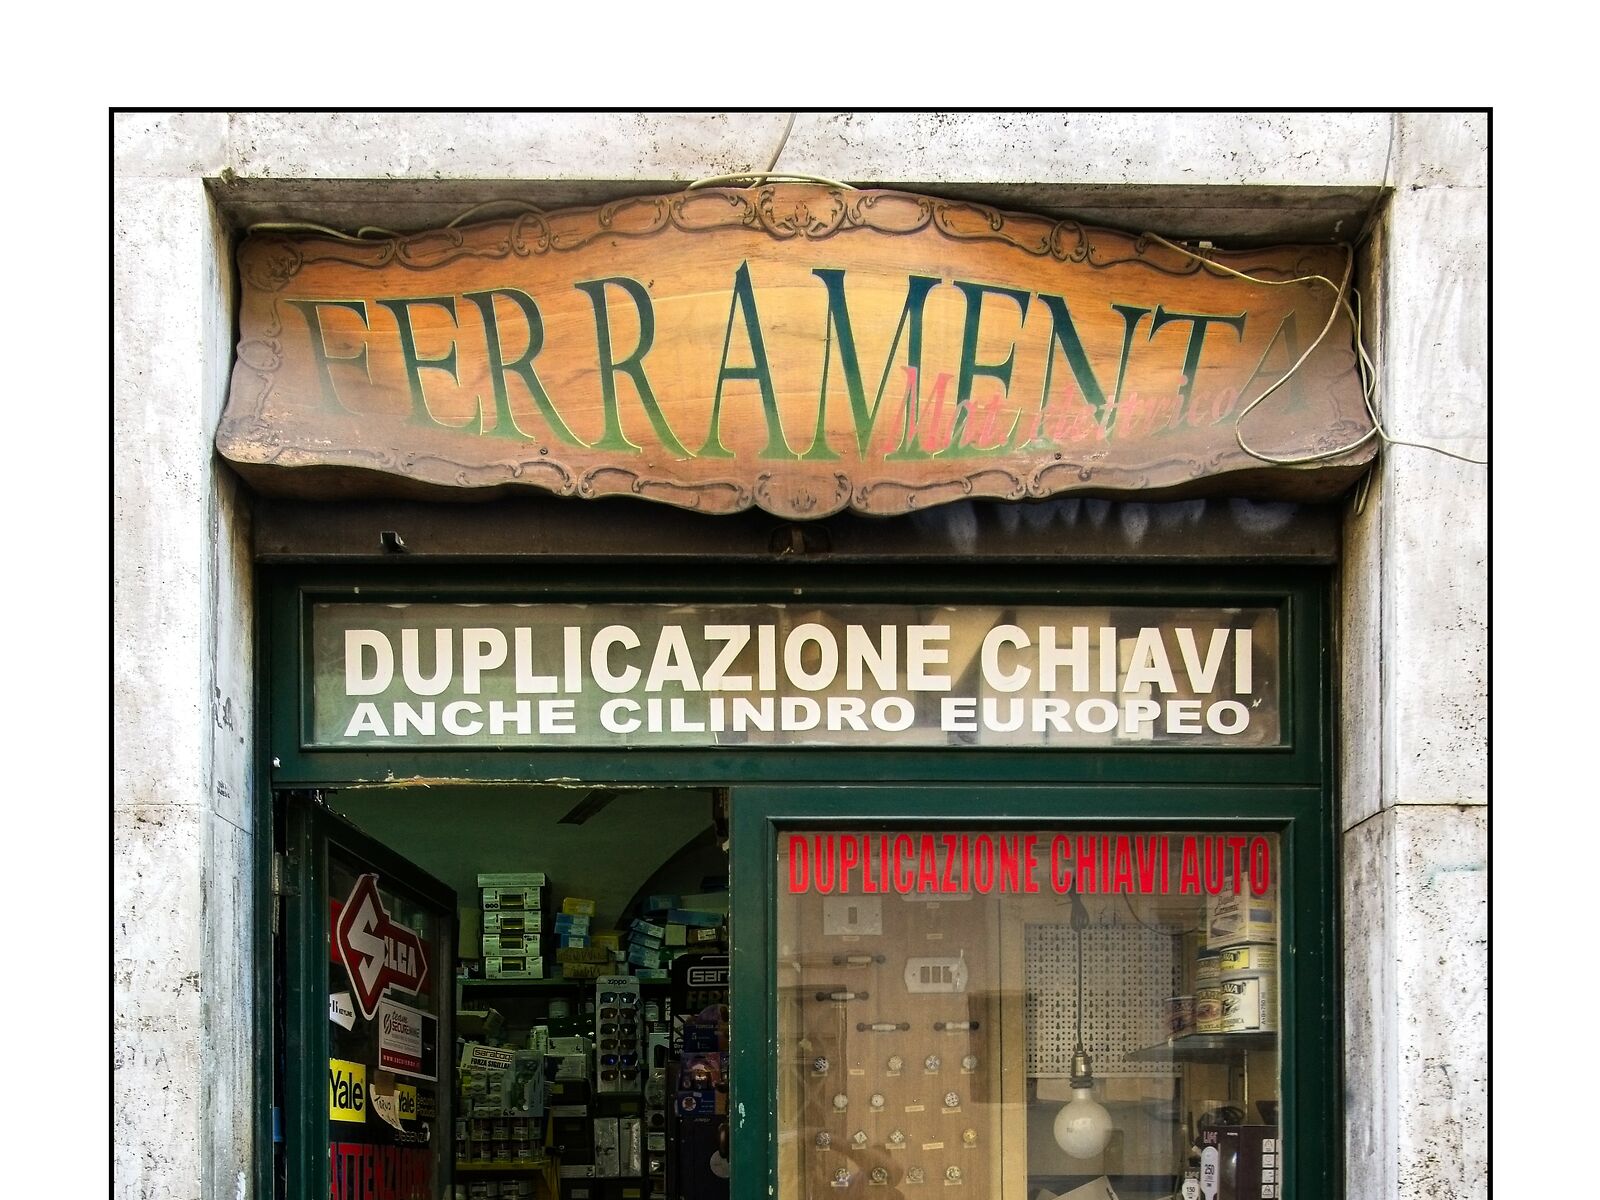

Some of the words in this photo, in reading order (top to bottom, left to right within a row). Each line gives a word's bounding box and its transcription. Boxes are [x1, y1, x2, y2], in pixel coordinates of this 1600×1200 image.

[284, 258, 1320, 464] FERRAMENTA
[345, 624, 952, 694] DUPLICAZIONE
[981, 625, 1253, 694] CHIAVI
[344, 699, 577, 736] ANCHE
[599, 697, 915, 735] CILINDRO
[942, 698, 1251, 737] EUROPEO
[788, 833, 1039, 896] DUPLICAZIONE
[1050, 834, 1170, 896] CHIAVI
[1180, 836, 1271, 896] AUTO
[692, 970, 729, 983] sar
[330, 1069, 364, 1111] Yale
